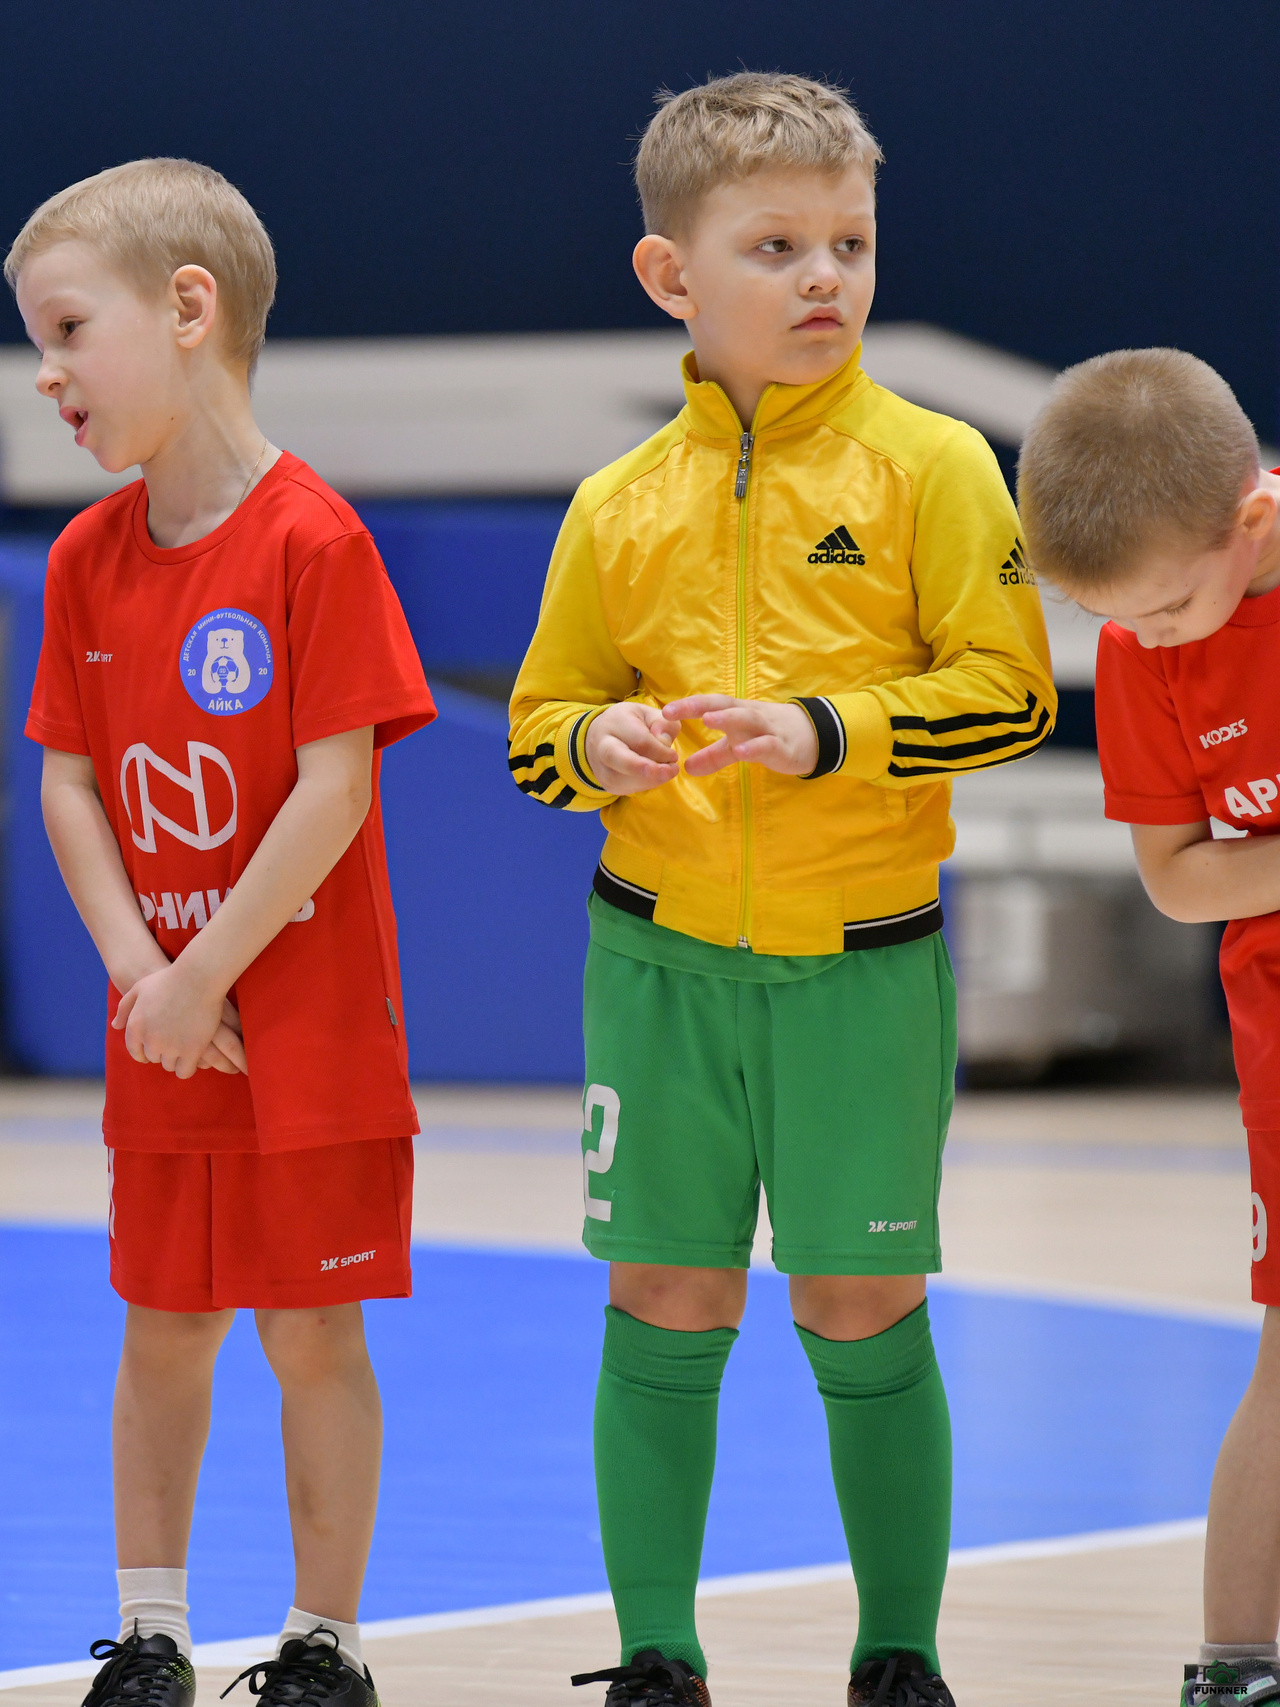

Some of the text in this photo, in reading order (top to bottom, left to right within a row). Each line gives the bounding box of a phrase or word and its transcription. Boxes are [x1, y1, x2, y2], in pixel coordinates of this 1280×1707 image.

[807, 550, 865, 566] adidas
[183, 612, 272, 664] ДЕТСКАЯ МИНИ-ФУТБОЛЬНАЯ КОМАНДА
[187, 668, 197, 677] 20
[258, 667, 269, 676] 20
[207, 697, 244, 712] АЙКА
[888, 1219, 918, 1232] SPORT
[340, 1249, 377, 1267] SPORT
